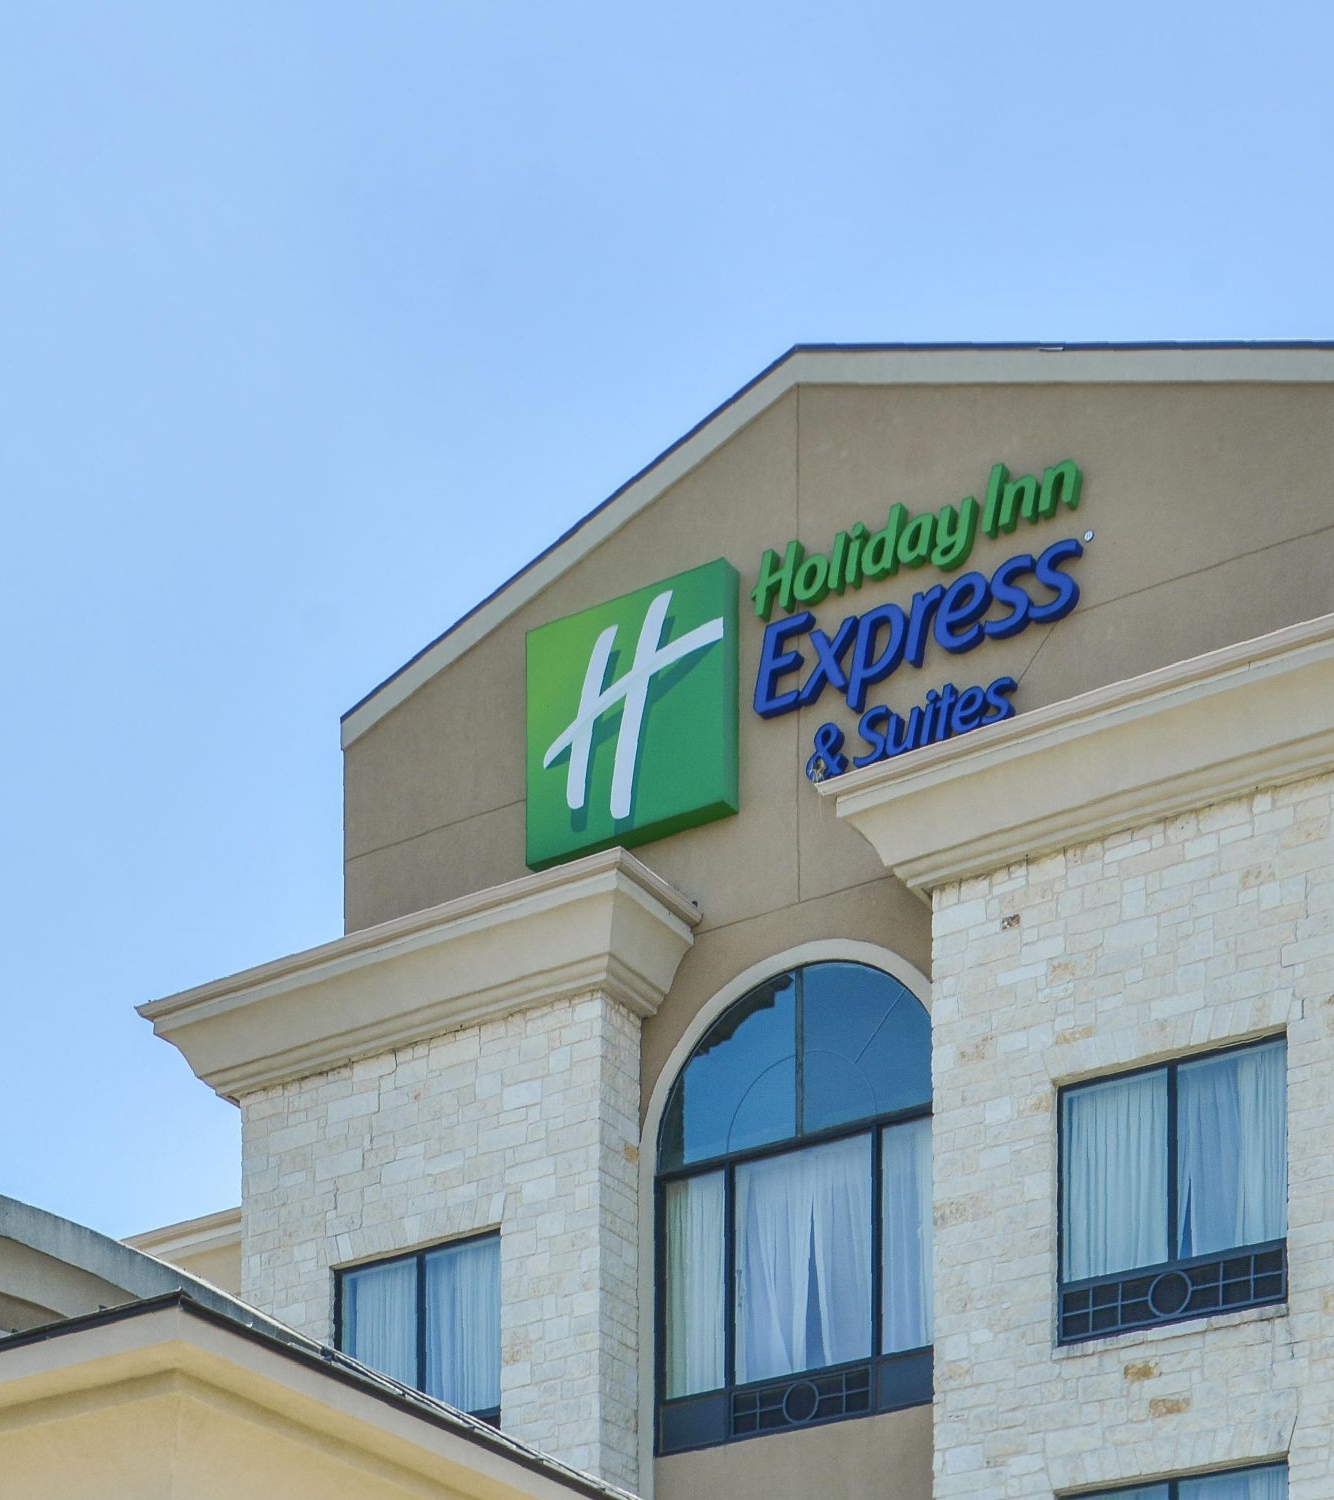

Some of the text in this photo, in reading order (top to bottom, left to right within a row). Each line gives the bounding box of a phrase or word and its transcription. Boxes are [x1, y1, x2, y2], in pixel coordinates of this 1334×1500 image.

[751, 459, 1083, 622] Holiday Inn
[753, 538, 1084, 719] Express
[806, 677, 1018, 783] & Suites
